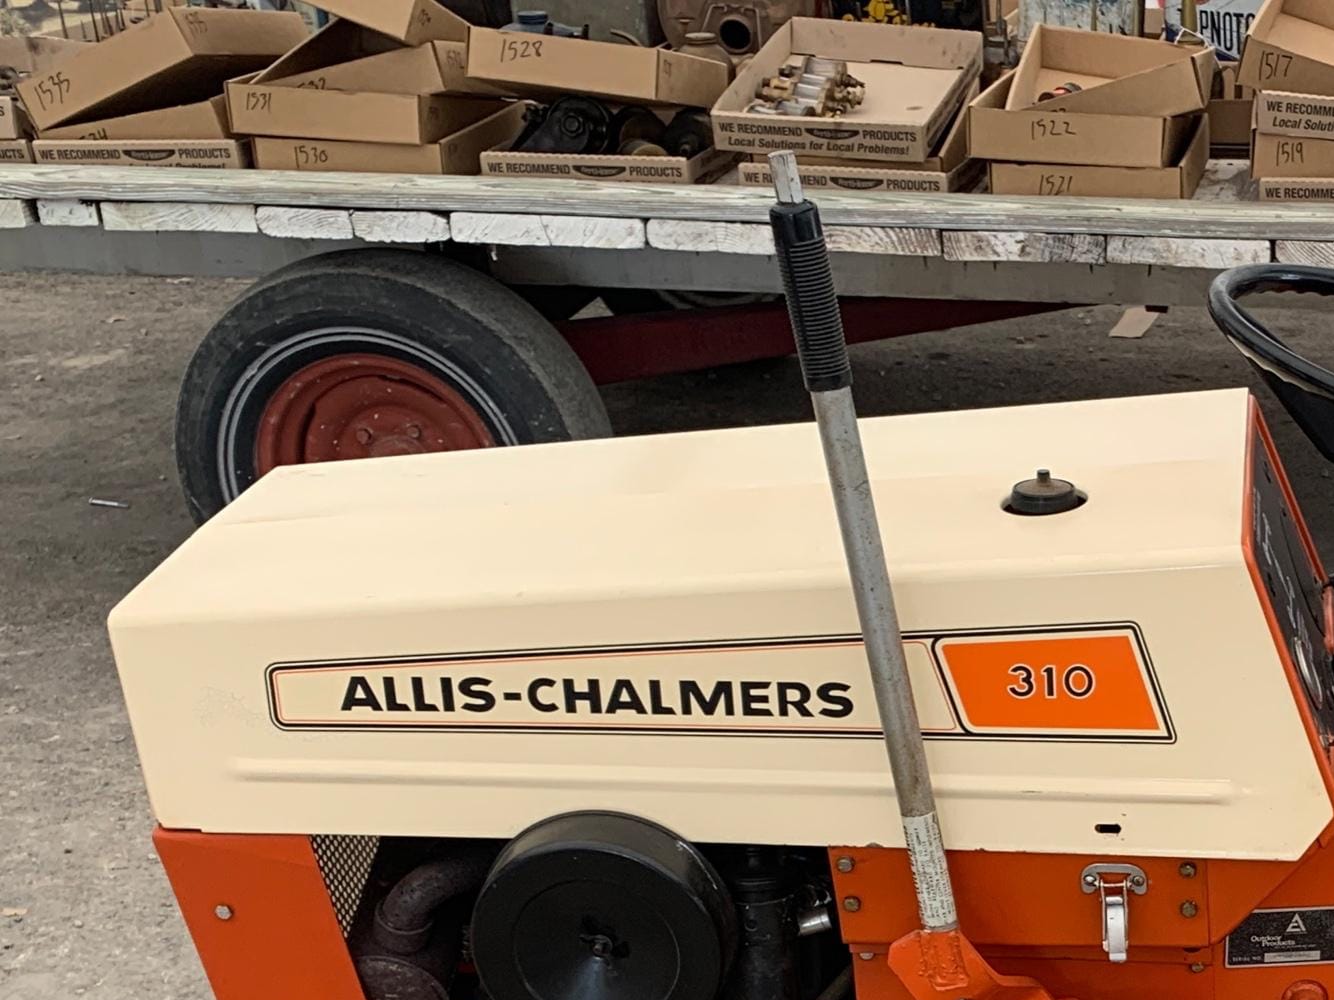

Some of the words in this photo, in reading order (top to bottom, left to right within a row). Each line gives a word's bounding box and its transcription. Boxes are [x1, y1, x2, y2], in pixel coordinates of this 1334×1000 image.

[500, 39, 543, 62] 1528
[1259, 51, 1293, 80] 1517
[246, 92, 272, 112] 1531
[1266, 100, 1283, 112] WE
[719, 122, 735, 133] WE
[738, 123, 802, 137] RECOMMEND
[862, 130, 917, 142] PRODUCTS
[1031, 119, 1076, 140] 1522
[1273, 116, 1301, 129] Local
[40, 149, 55, 160] WE
[57, 149, 121, 160] RECOMMEND
[178, 148, 231, 159] PRODUCTS
[728, 136, 755, 147] Local
[758, 138, 807, 150] Solutions
[809, 139, 825, 150] for
[826, 141, 855, 152] Local
[857, 143, 910, 155] Problems!
[1276, 141, 1304, 166] 1519
[294, 145, 328, 168] 1530
[488, 162, 503, 173] WE
[506, 163, 570, 175] RECOMMEND
[629, 167, 682, 178] PRODUCTS
[744, 172, 760, 183] WE
[762, 173, 827, 186] RMEND
[886, 179, 940, 191] PRODUCTS
[1039, 174, 1073, 196] 1521
[1265, 187, 1282, 198] WE
[1007, 664, 1096, 700] 310
[341, 675, 854, 719] ALLIS-CHALMERS
[1250, 934, 1283, 943] Outdoor
[1262, 938, 1296, 947] Products
